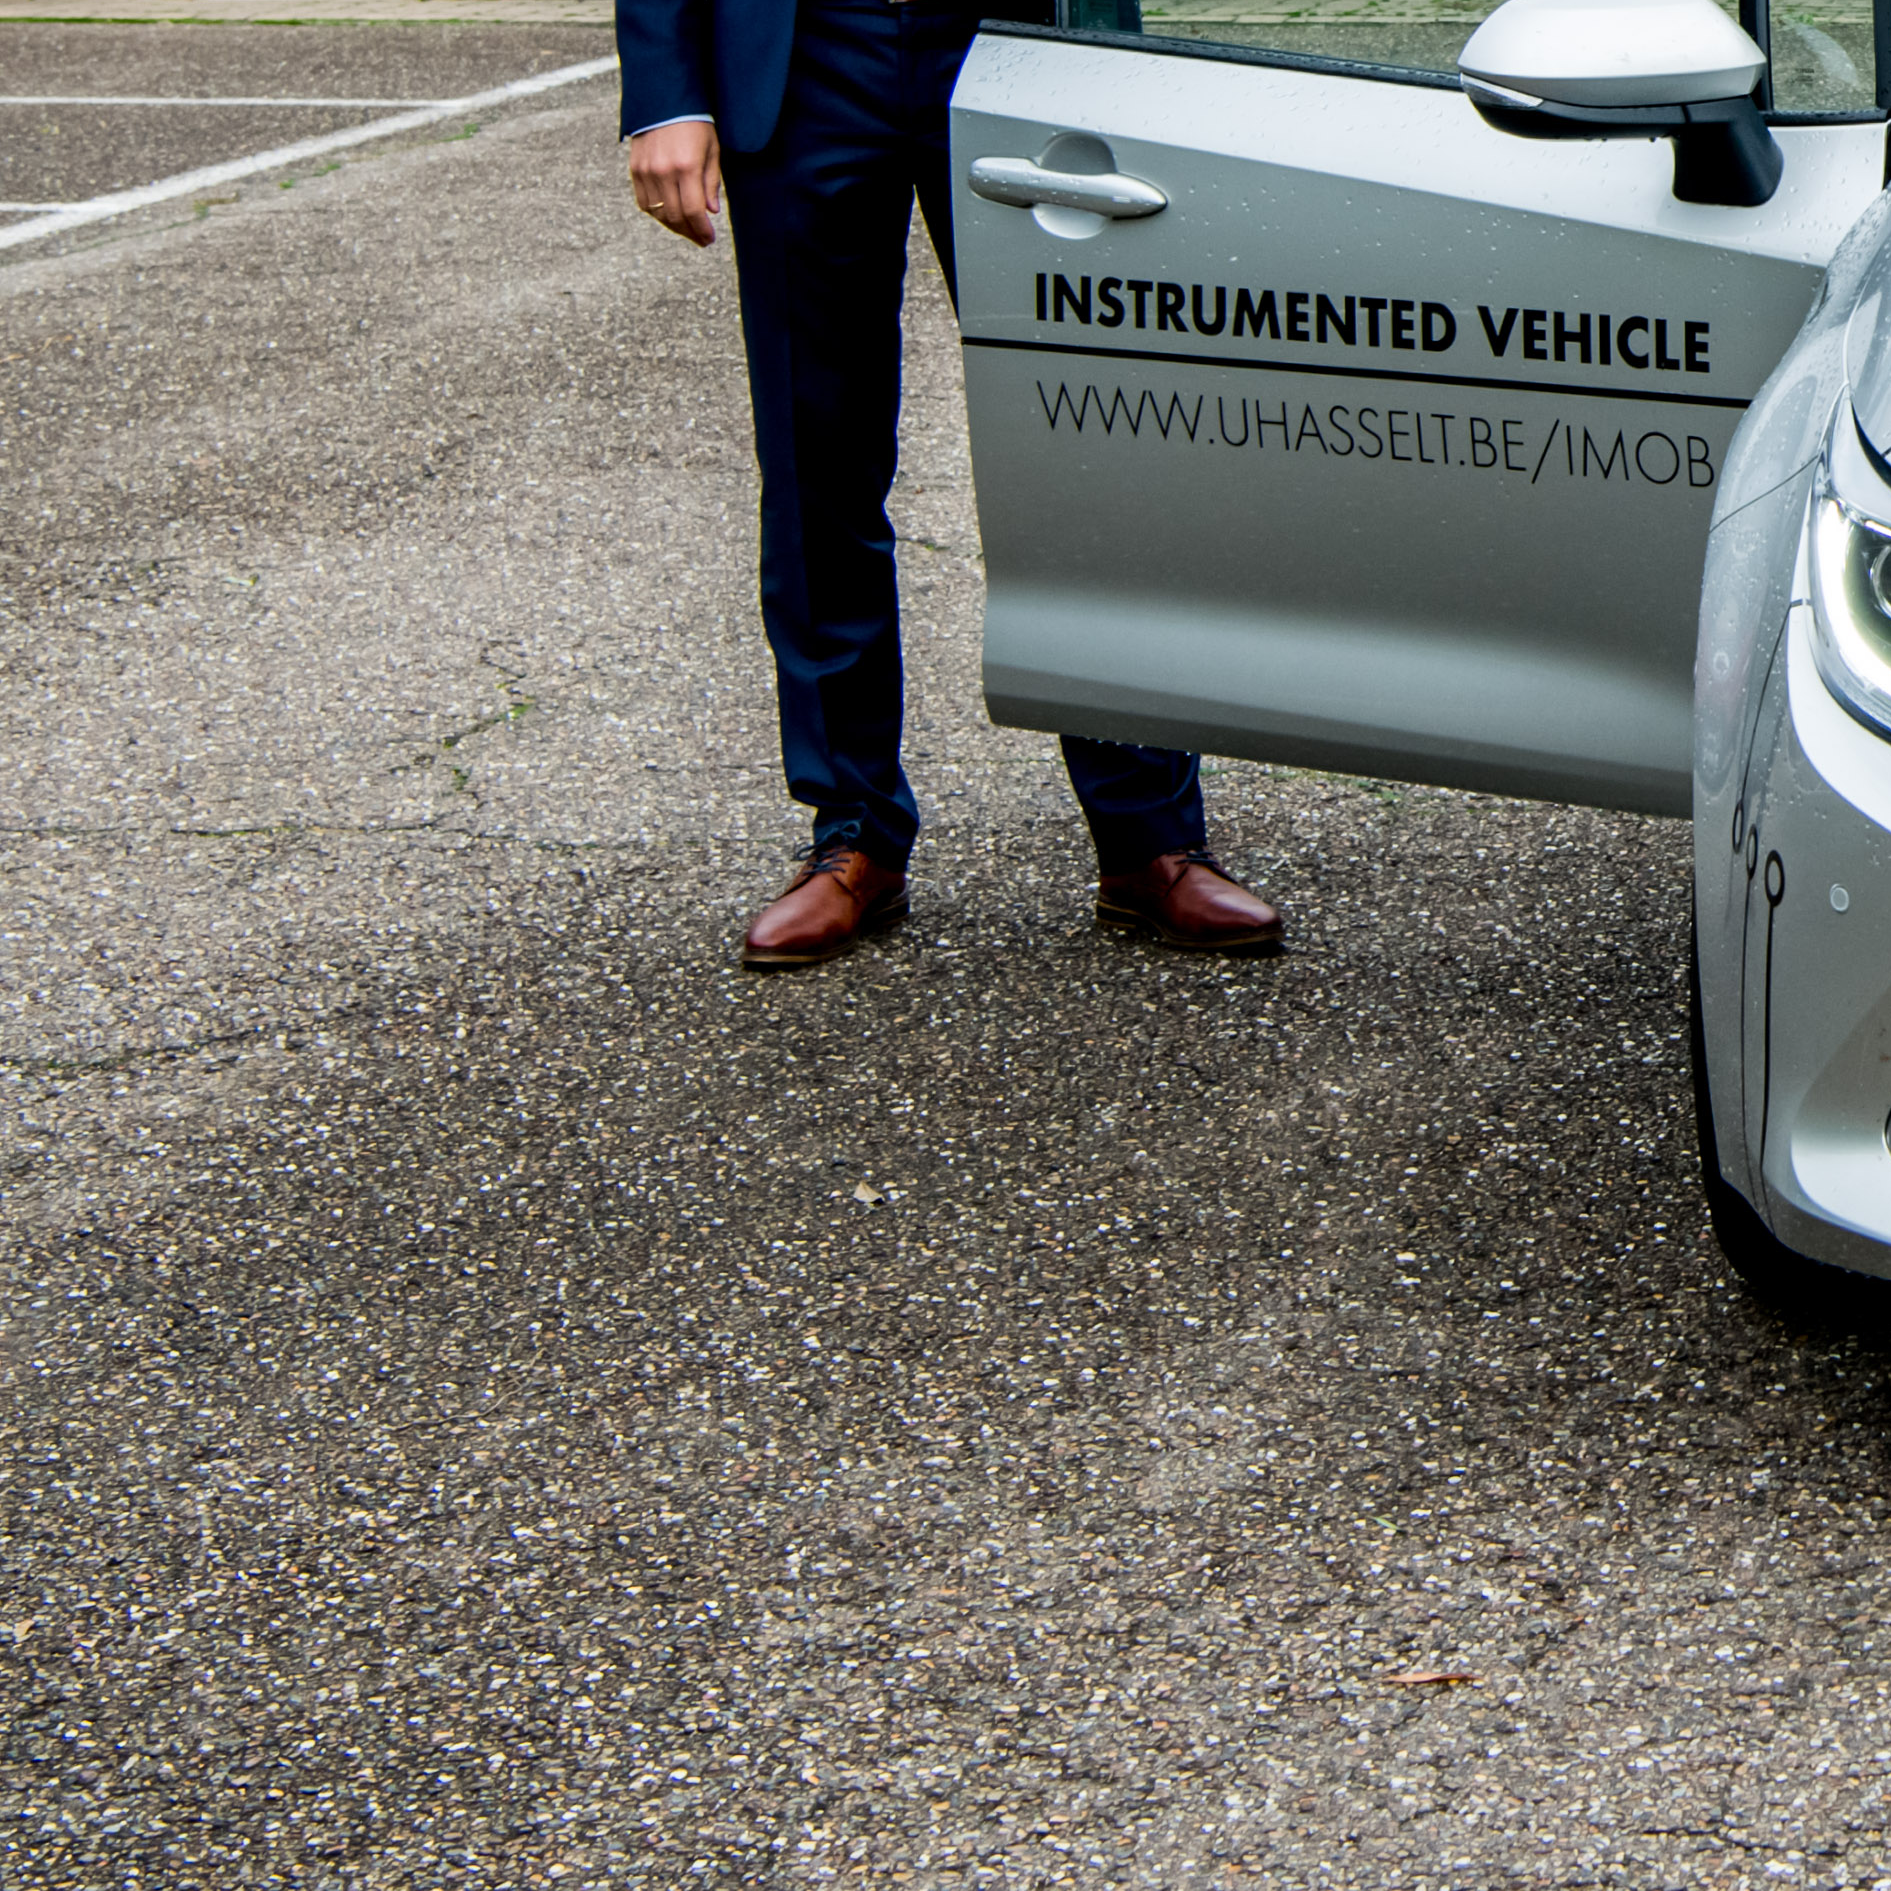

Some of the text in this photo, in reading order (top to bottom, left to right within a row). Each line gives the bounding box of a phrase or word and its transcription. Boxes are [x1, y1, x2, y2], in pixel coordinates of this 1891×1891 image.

[1034, 272, 1712, 373] INSTRUMENTED VEHICLE
[1036, 379, 1716, 489] WWW.UHASSELT.BE/IMOB
